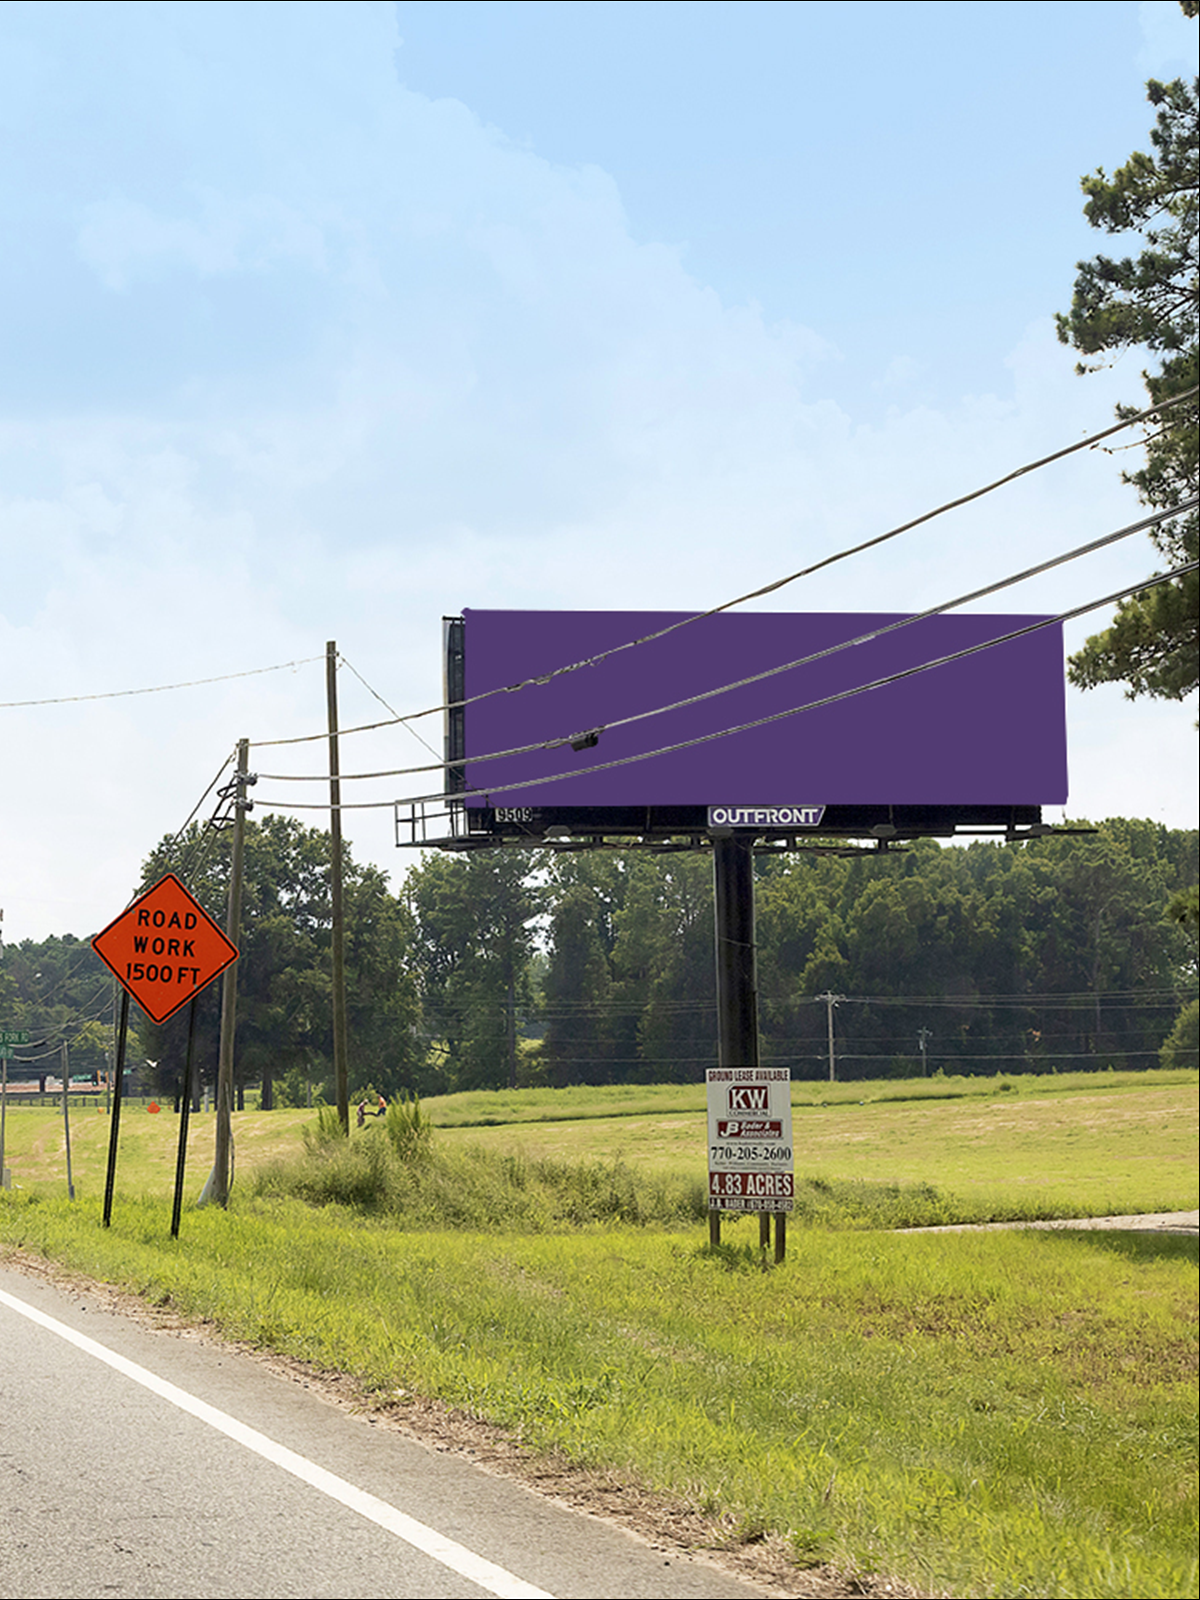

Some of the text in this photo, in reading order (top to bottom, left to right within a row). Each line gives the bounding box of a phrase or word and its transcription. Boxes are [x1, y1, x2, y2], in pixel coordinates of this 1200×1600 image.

[498, 807, 531, 822] 9509
[712, 808, 819, 824] OUTFRONT
[138, 909, 197, 930] ROAD
[133, 936, 196, 957] WORK
[127, 962, 201, 985] 1500 FT
[709, 1070, 788, 1081] GROUND LEASE AVAILABLE
[731, 1089, 767, 1109] KW
[711, 1146, 791, 1160] 770-205-2600
[712, 1174, 791, 1195] 4.83 ACRES
